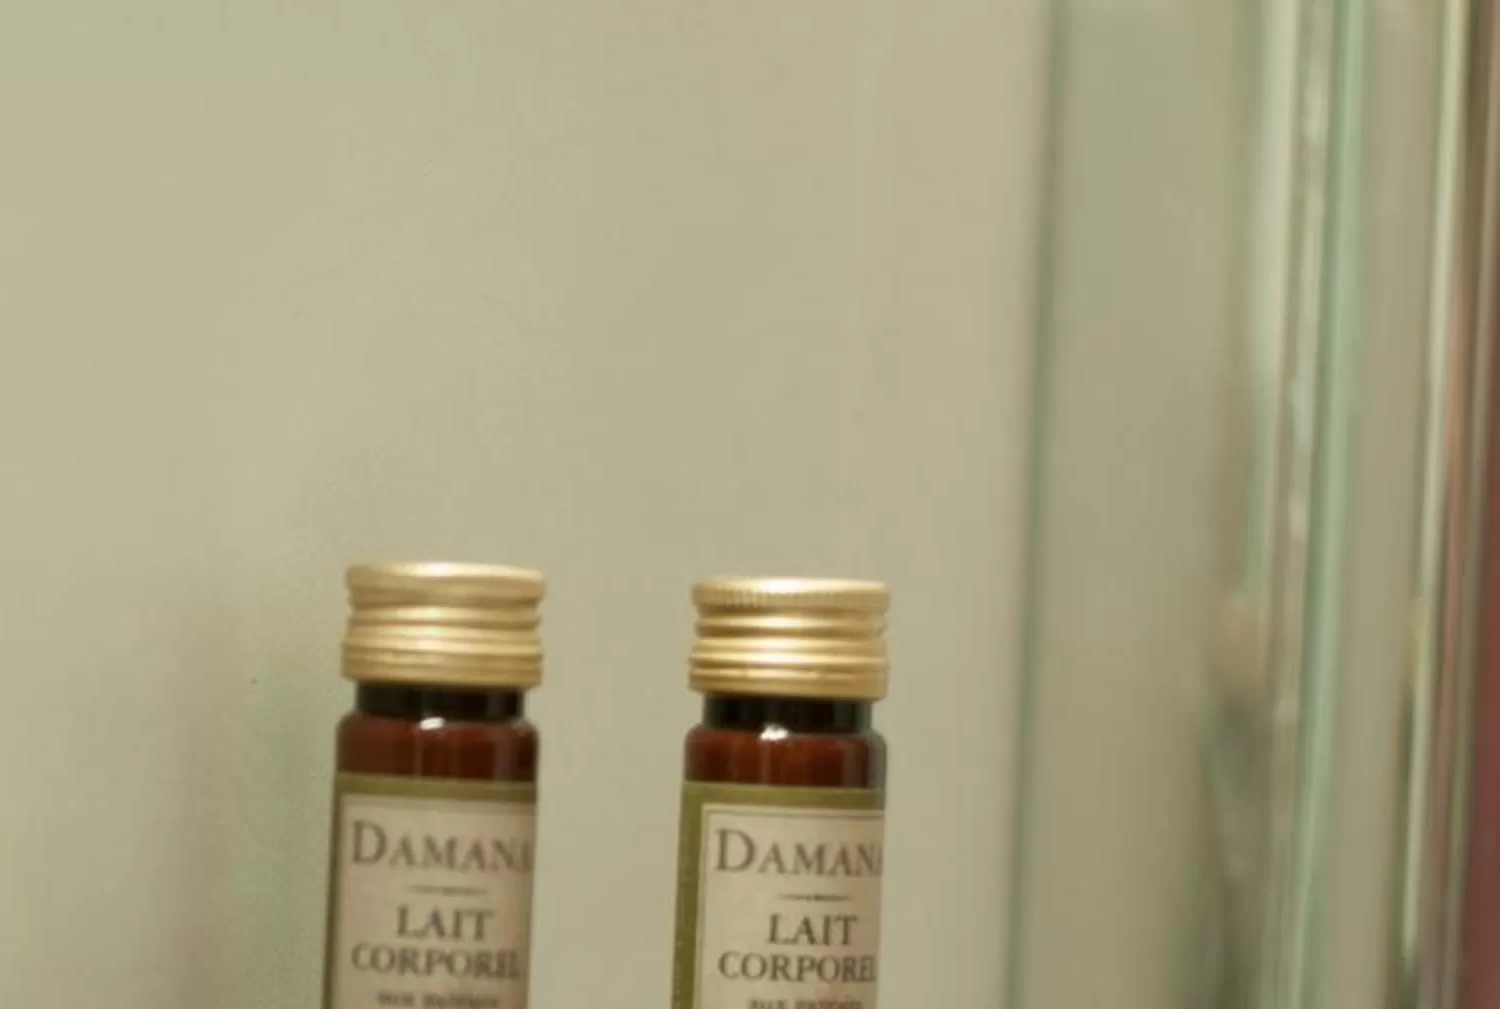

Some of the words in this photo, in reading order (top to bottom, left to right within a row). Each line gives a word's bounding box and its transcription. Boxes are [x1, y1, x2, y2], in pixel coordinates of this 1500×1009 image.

[714, 826, 883, 877] DAMAN
[396, 904, 494, 941] LAIT
[766, 912, 858, 946] LAIT
